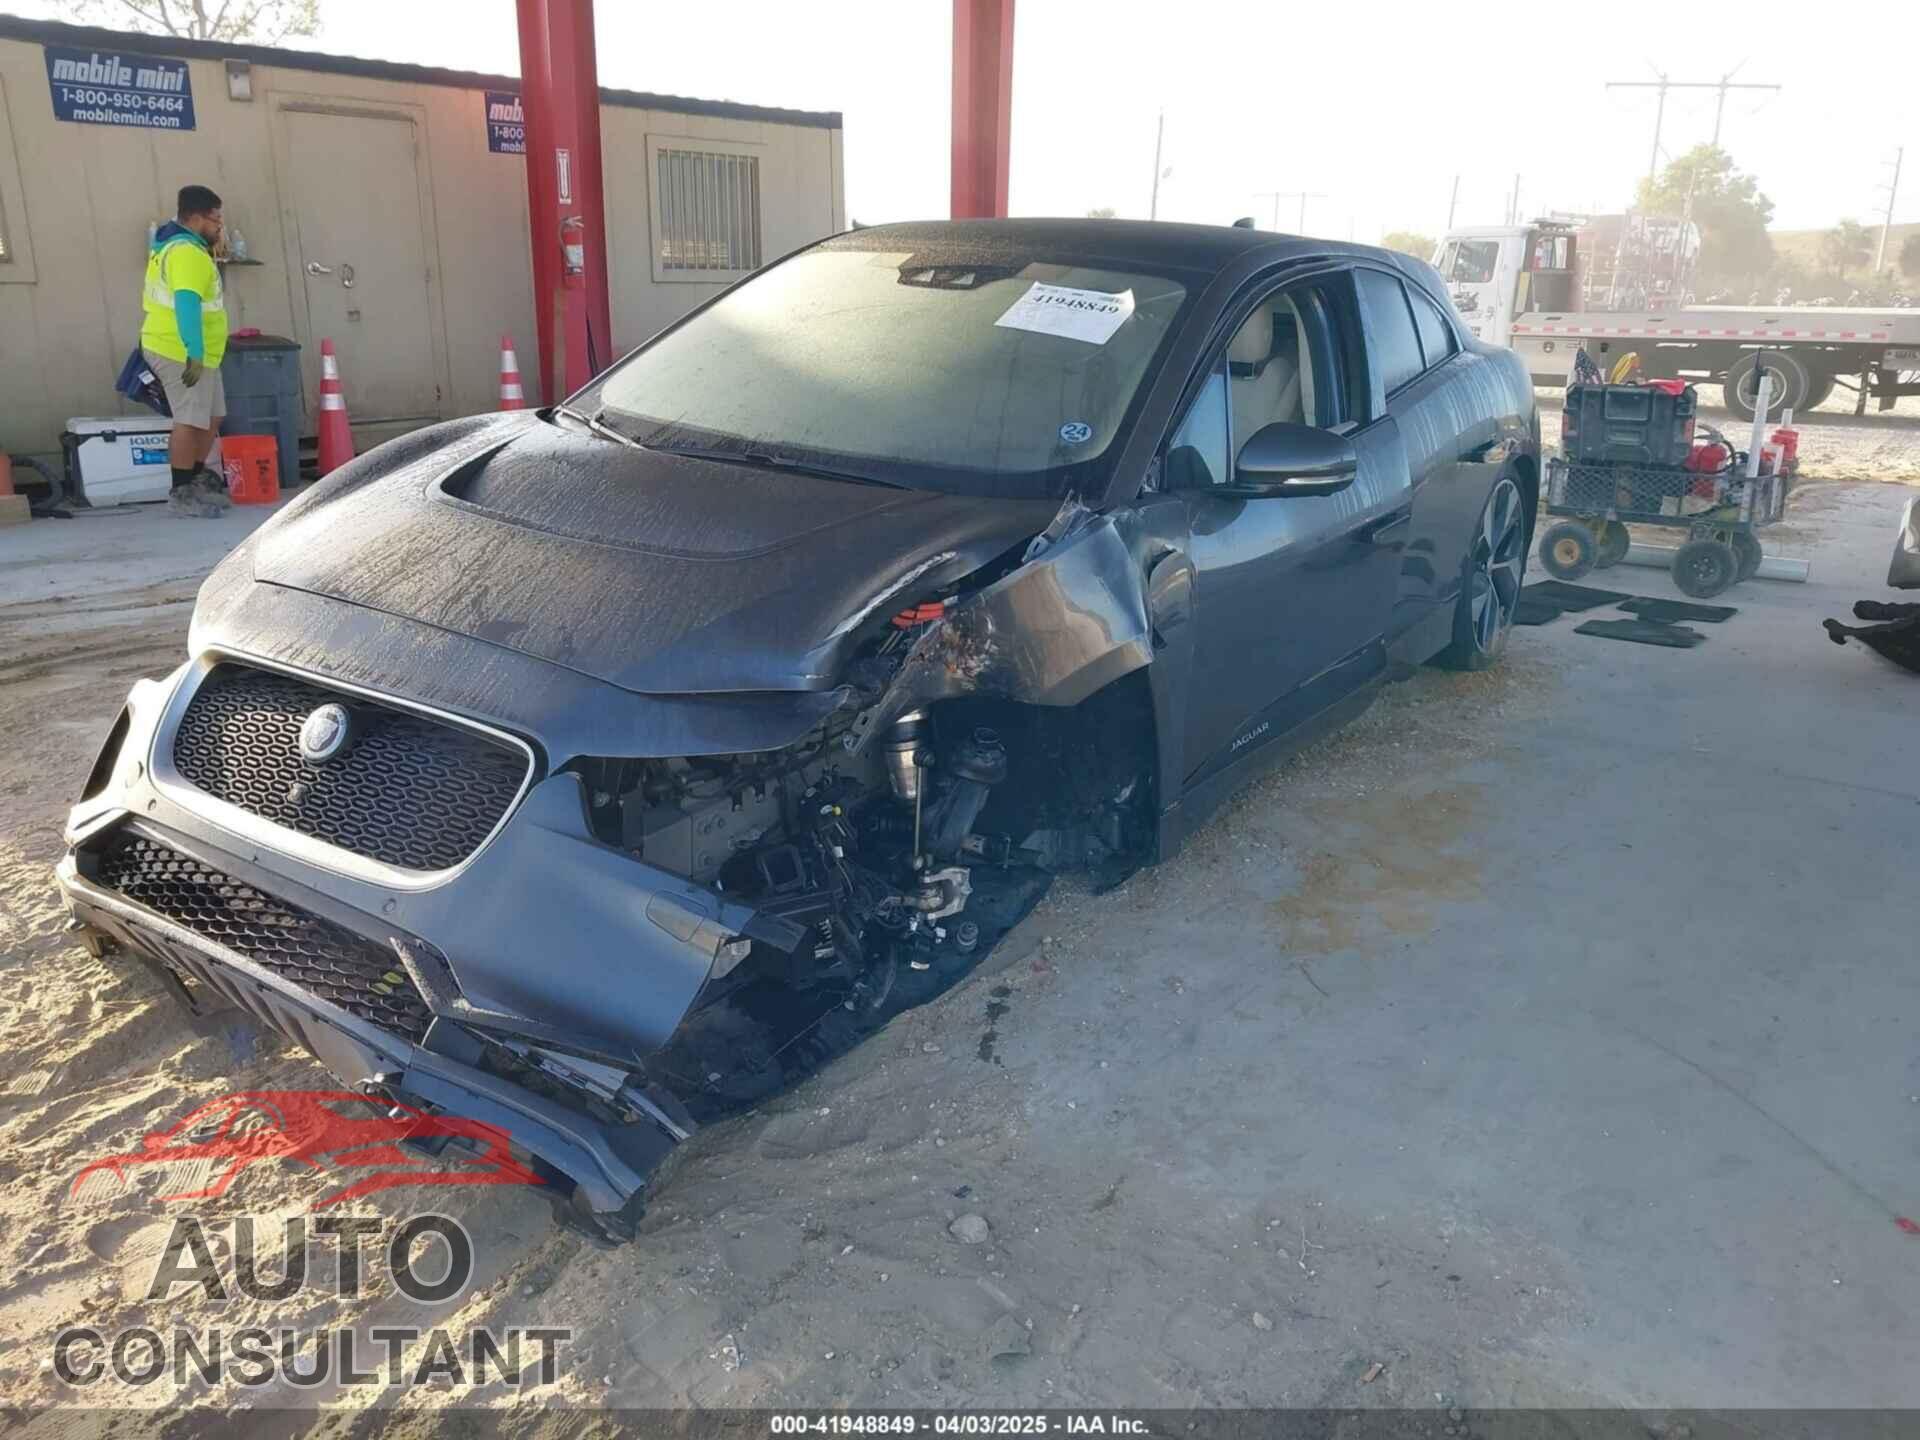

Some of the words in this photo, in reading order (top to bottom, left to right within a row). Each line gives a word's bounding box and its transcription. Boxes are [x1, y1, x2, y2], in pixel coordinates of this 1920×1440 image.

[53, 53, 132, 86] mobile
[135, 65, 187, 91] mini
[61, 88, 184, 112] 1-800-950-6464
[73, 108, 180, 127] mobilemini.com
[1033, 294, 1120, 314] 41948849
[1064, 424, 1088, 438] 24
[1230, 721, 1269, 752] JAGUAR
